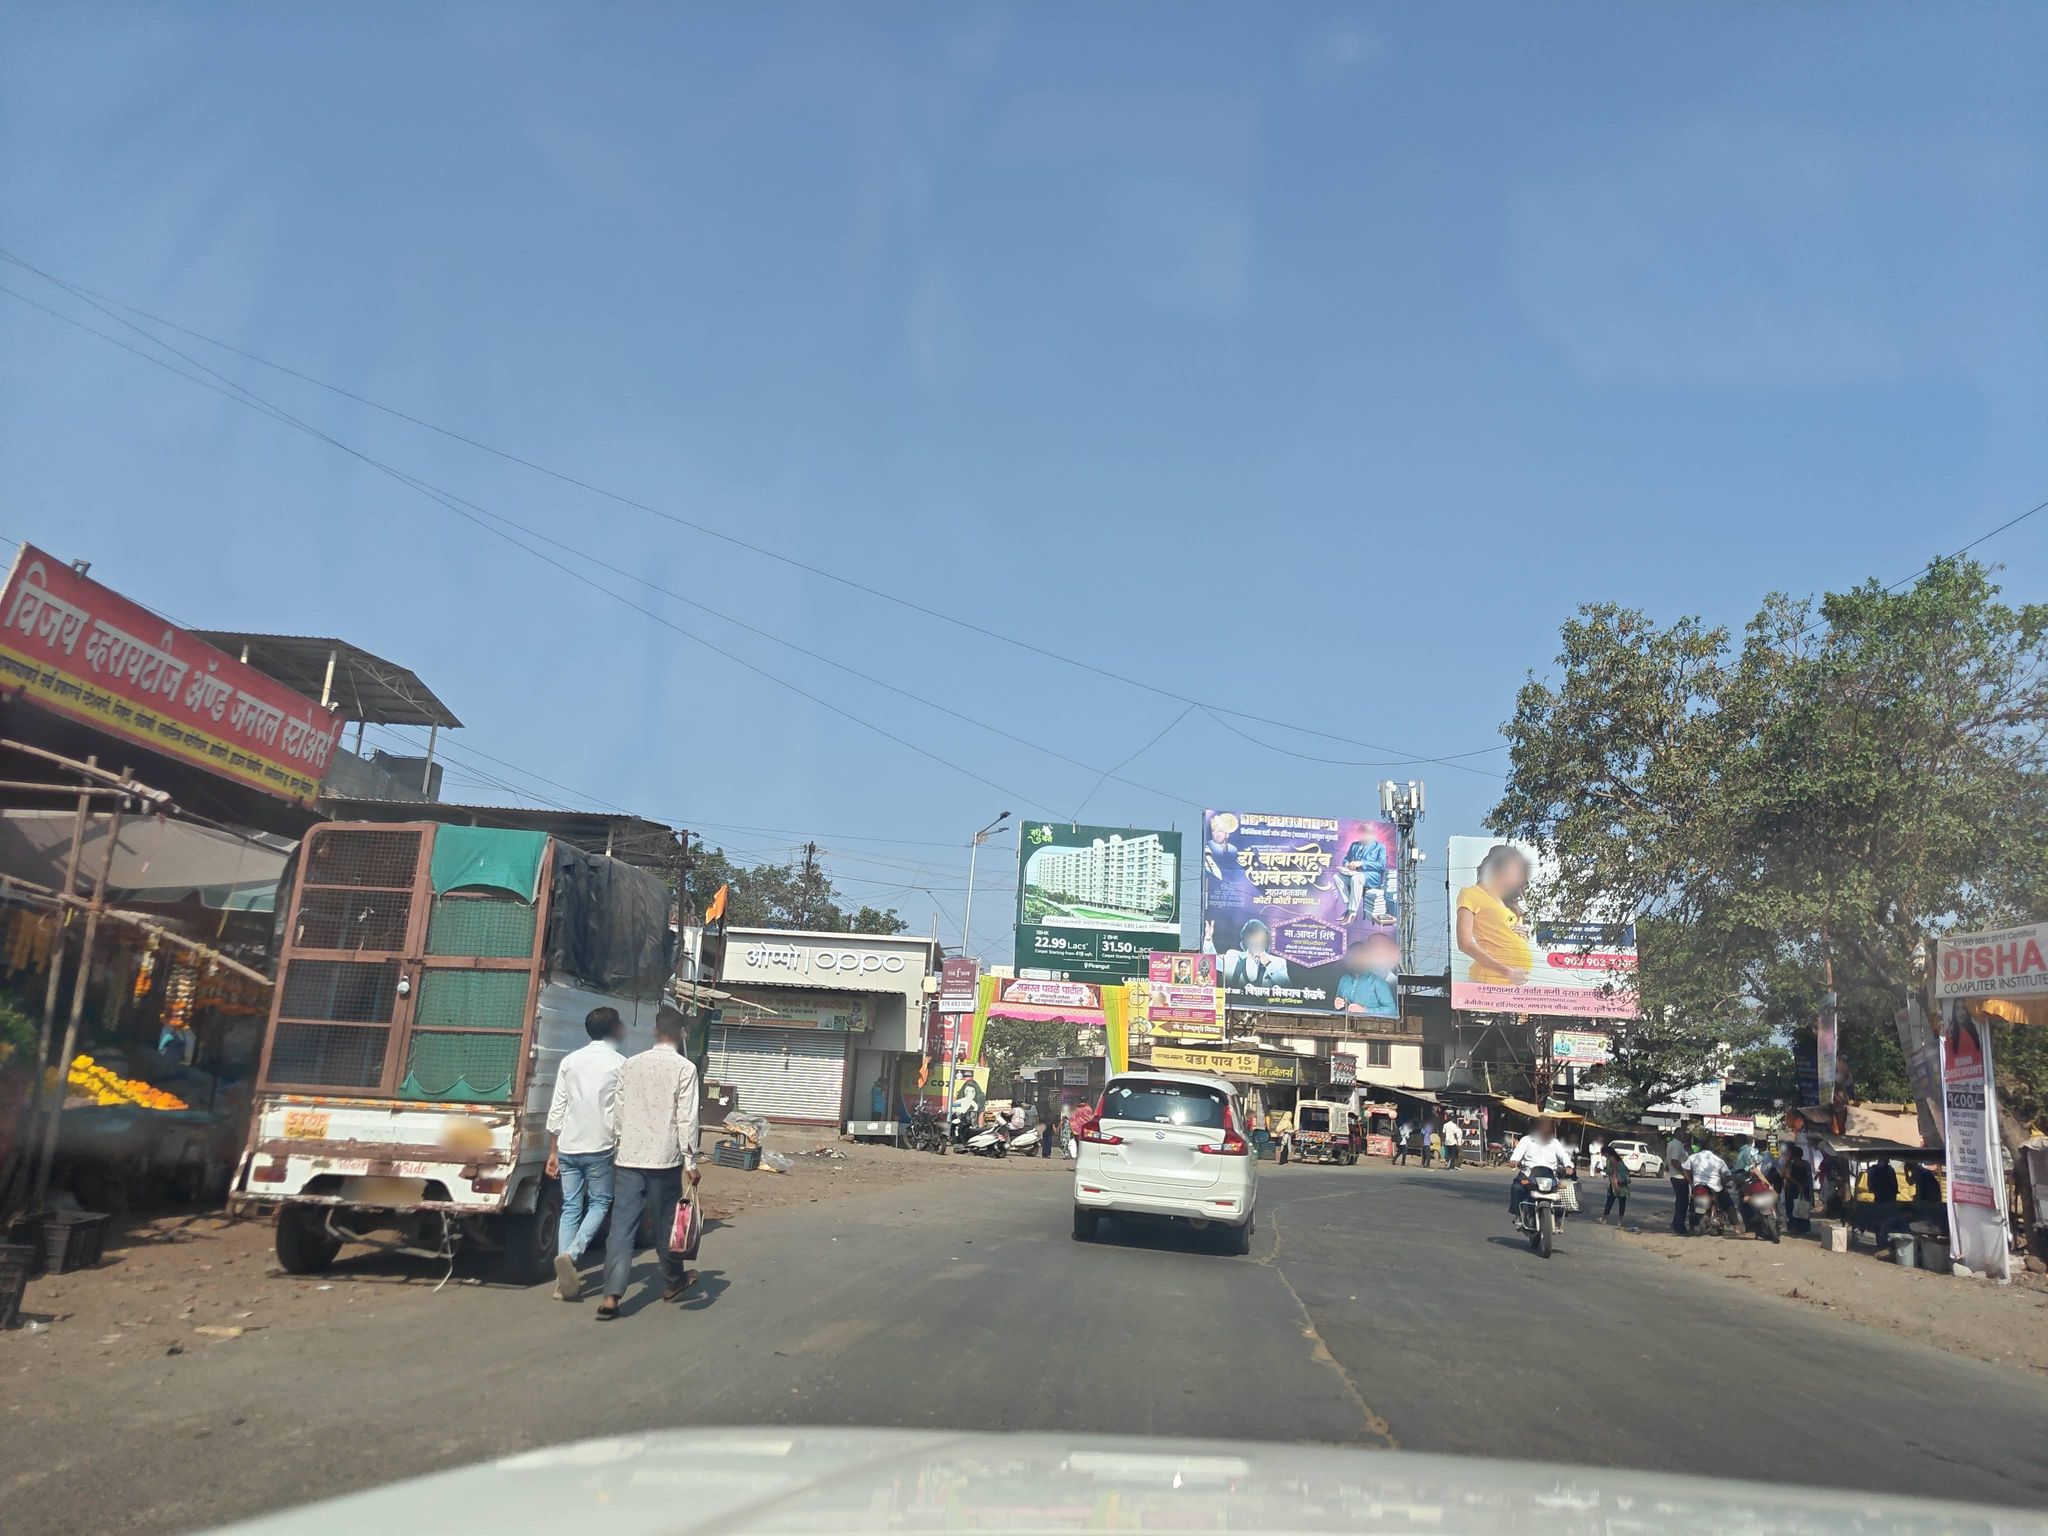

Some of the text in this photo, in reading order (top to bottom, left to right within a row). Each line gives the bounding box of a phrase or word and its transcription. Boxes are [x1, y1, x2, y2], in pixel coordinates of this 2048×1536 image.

[4, 561, 91, 656] विजय
[85, 618, 190, 702] व्हरायटीज
[231, 690, 286, 747] जनरल
[281, 707, 341, 769] स्टोअर्स
[1034, 936, 1067, 949] 22.99
[1963, 939, 1974, 947] ISO
[2008, 929, 2037, 939] Certified
[1049, 949, 1065, 957] Starting
[1101, 941, 1133, 953] 31.50
[744, 941, 801, 970] ओप्पो
[815, 950, 906, 977] oppo
[1089, 962, 1110, 970] Pirangut
[1016, 983, 1040, 993] समस्त
[1062, 984, 1084, 995] पाटील
[1944, 974, 2048, 994] COMPUTER INSTITUTE
[1185, 1053, 1207, 1066] वडा
[1211, 1055, 1233, 1068] पाव
[287, 1112, 328, 1127] STOP
[1958, 1129, 1974, 1137] TALLY
[402, 1161, 428, 1175] Side
